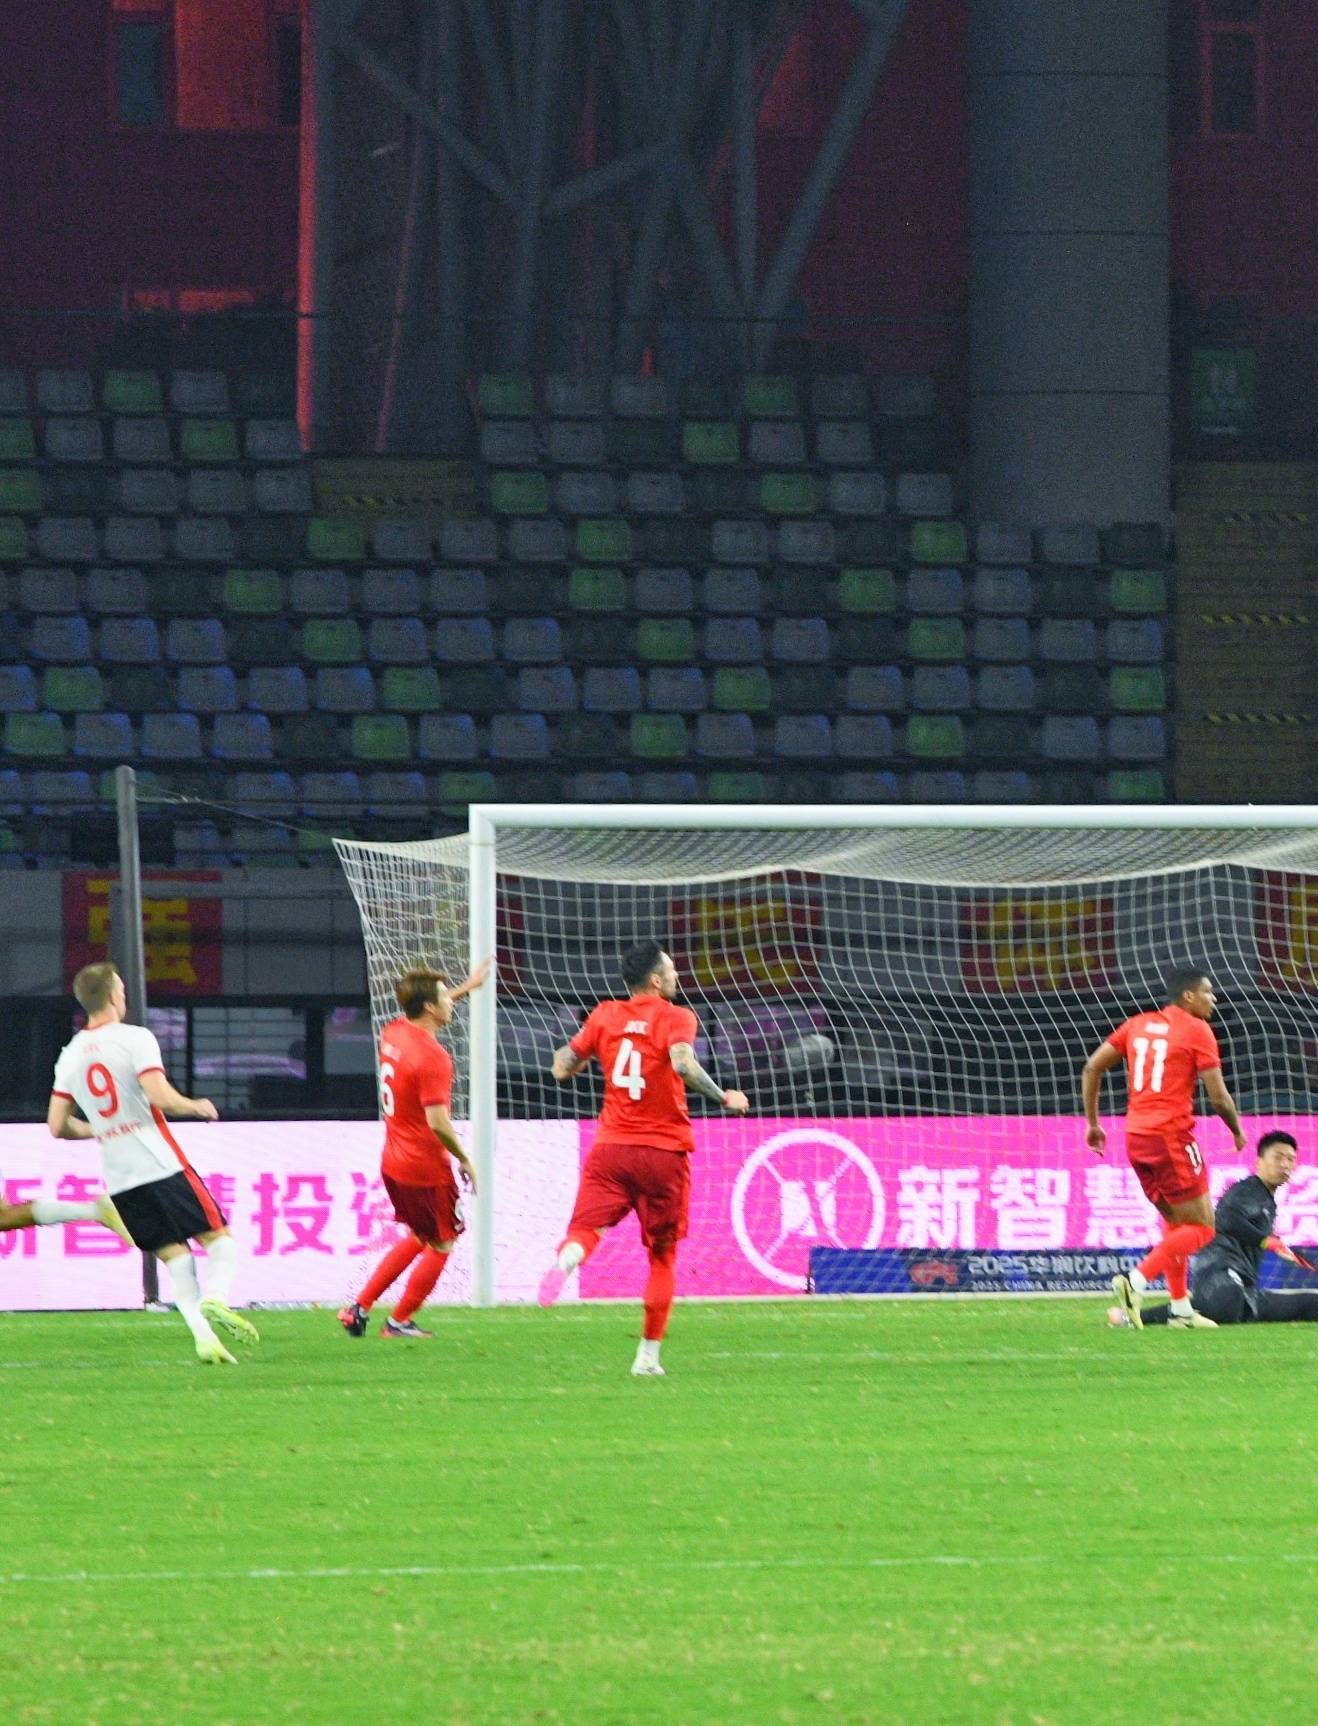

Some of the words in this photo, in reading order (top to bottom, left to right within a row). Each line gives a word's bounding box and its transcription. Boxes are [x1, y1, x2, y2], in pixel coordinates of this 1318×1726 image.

[86, 1062, 118, 1118] 9
[380, 1062, 395, 1117] 6
[611, 1037, 645, 1100] 4
[1132, 1037, 1168, 1093] 11
